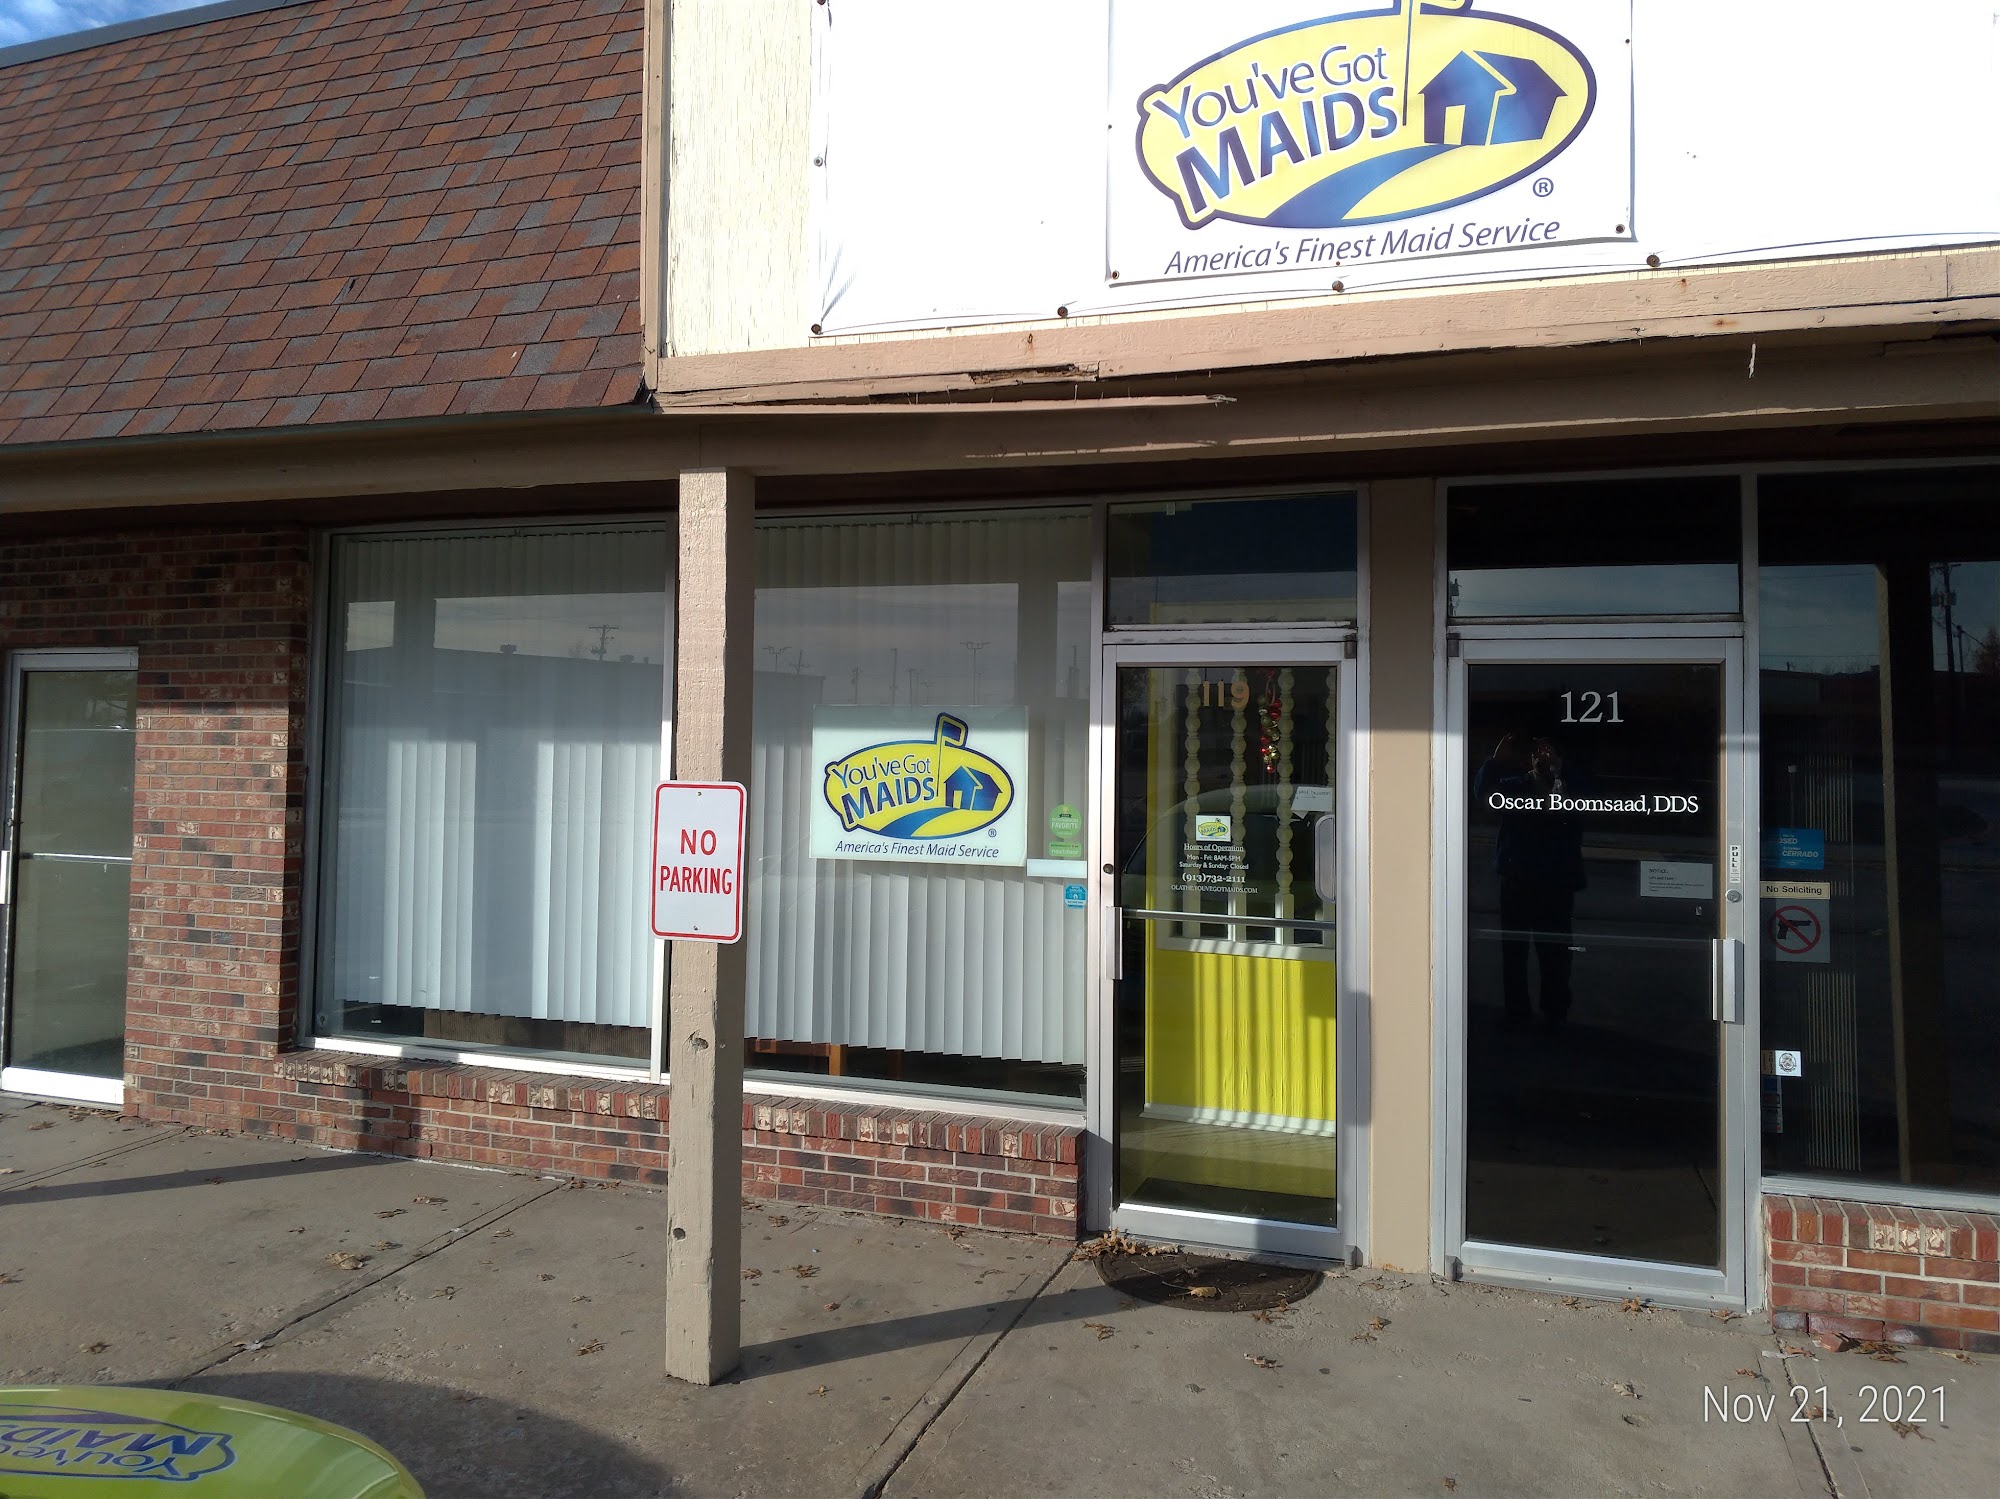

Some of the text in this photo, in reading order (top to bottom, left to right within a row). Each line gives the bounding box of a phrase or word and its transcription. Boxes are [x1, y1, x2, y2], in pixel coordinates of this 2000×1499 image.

[1153, 45, 1389, 139] You've Got
[1176, 86, 1397, 214] MAIDS
[1164, 217, 1560, 275] America's Finest Maid Service
[1203, 680, 1250, 708] 119
[1560, 691, 1624, 723] 121
[832, 755, 931, 789] You've Got
[840, 777, 935, 825] MAIDS
[1488, 792, 1699, 815] Oscar Boomsaad, DDS
[1051, 821, 1078, 829] FAVORITE
[680, 829, 717, 856] NO
[835, 840, 999, 858] America's Finest Maid Service
[1184, 843, 1203, 851] Hours
[1211, 844, 1244, 852] Operation
[1179, 861, 1202, 869] Saturday
[1731, 846, 1739, 868] PULL
[660, 866, 732, 895] PARKING
[1182, 872, 1246, 883] (913)732-2111
[1766, 885, 1822, 895] No Soliciting
